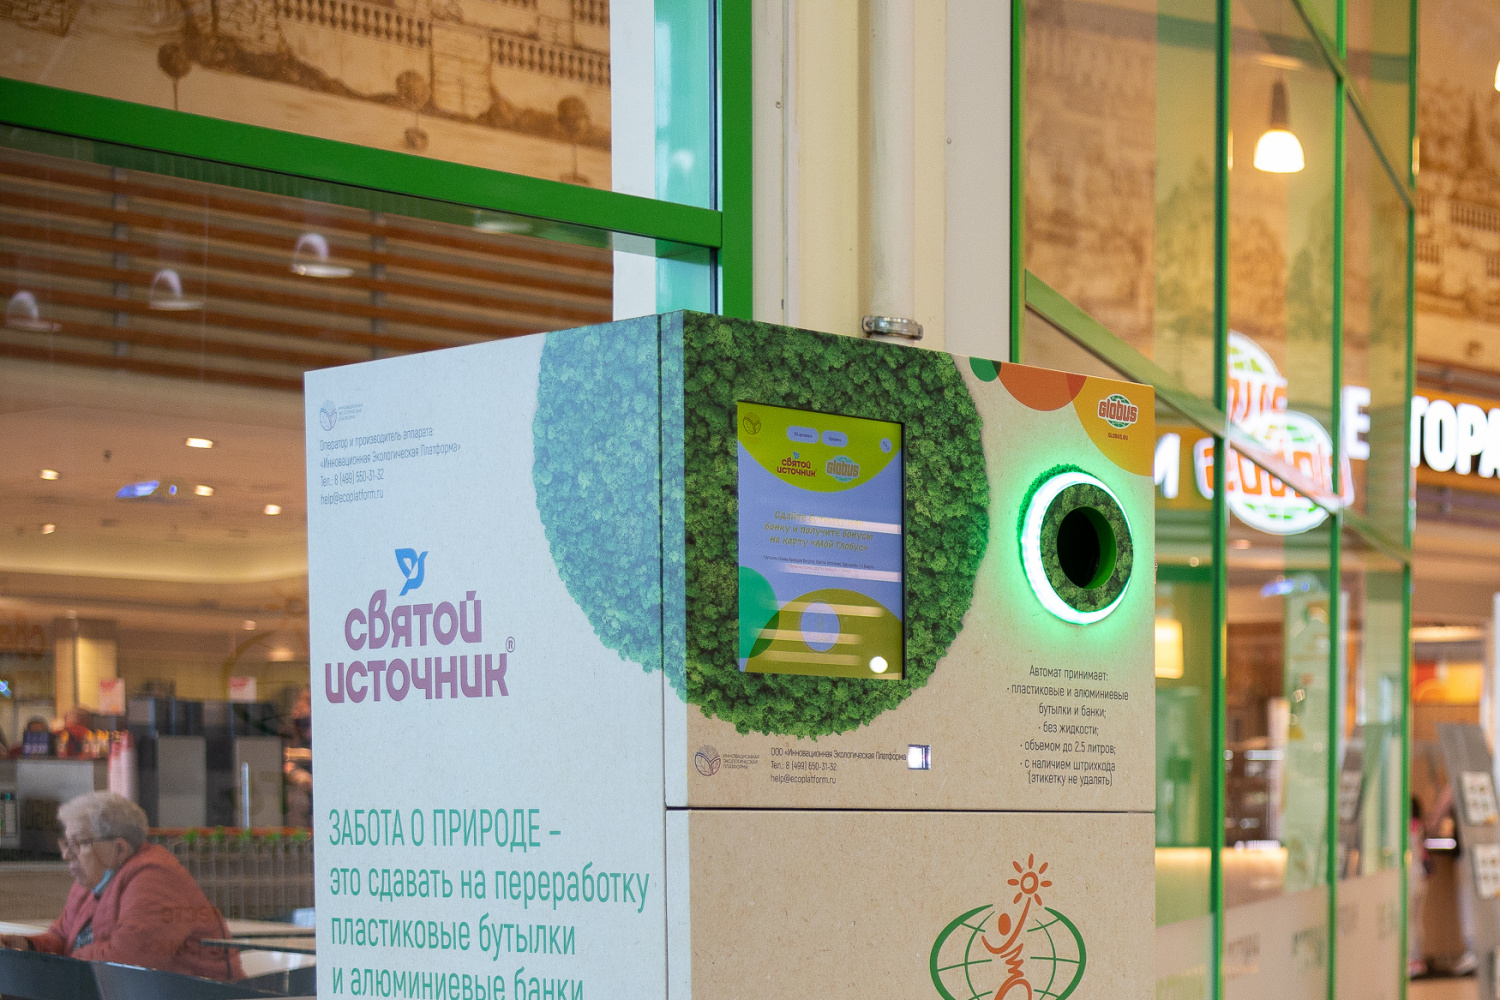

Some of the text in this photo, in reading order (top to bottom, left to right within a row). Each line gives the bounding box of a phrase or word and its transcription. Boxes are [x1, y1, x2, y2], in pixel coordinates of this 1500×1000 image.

[320, 427, 435, 452] Оператор и производитель аппарата:
[1107, 432, 1129, 441] GLOBUS.RU
[320, 442, 462, 469] «Инновационная Экологическая Платформа»
[334, 474, 338, 486] 8
[340, 470, 355, 487] (499)
[356, 468, 385, 484] 550-31-32
[320, 489, 384, 506] help@ecoplatform.ru
[774, 510, 806, 521] Сдайте
[764, 521, 790, 534] банку
[800, 526, 840, 537] получите
[842, 529, 873, 541] бонусы
[782, 536, 809, 548] карту
[1029, 664, 1109, 681] Автомат принимает:
[1011, 684, 1129, 701] пластиковые и алюминиевые
[1038, 702, 1107, 719] бутылки и банки;
[1043, 721, 1099, 737] без жидкости;
[771, 747, 784, 757] ООО
[784, 748, 833, 759] «Инновационная
[833, 750, 875, 760] Экологическая
[1024, 739, 1061, 752] объемом
[1062, 742, 1073, 753] до
[1087, 743, 1117, 756] литров;
[771, 760, 784, 770] Тел.:
[786, 761, 790, 769] 8
[791, 761, 807, 771] (499)
[1024, 759, 1116, 773] с наличием штрихкода
[771, 774, 836, 785] help@ecoplatform.ru
[1028, 770, 1113, 787] (этикетку не удалять)
[329, 808, 405, 847] ЗАБОТА
[411, 808, 424, 847] О
[433, 808, 541, 853] ПРИРОДЕ
[330, 861, 650, 914] это сдавать на переработку
[331, 912, 576, 962] пластиковые бутылки
[332, 966, 343, 994] и
